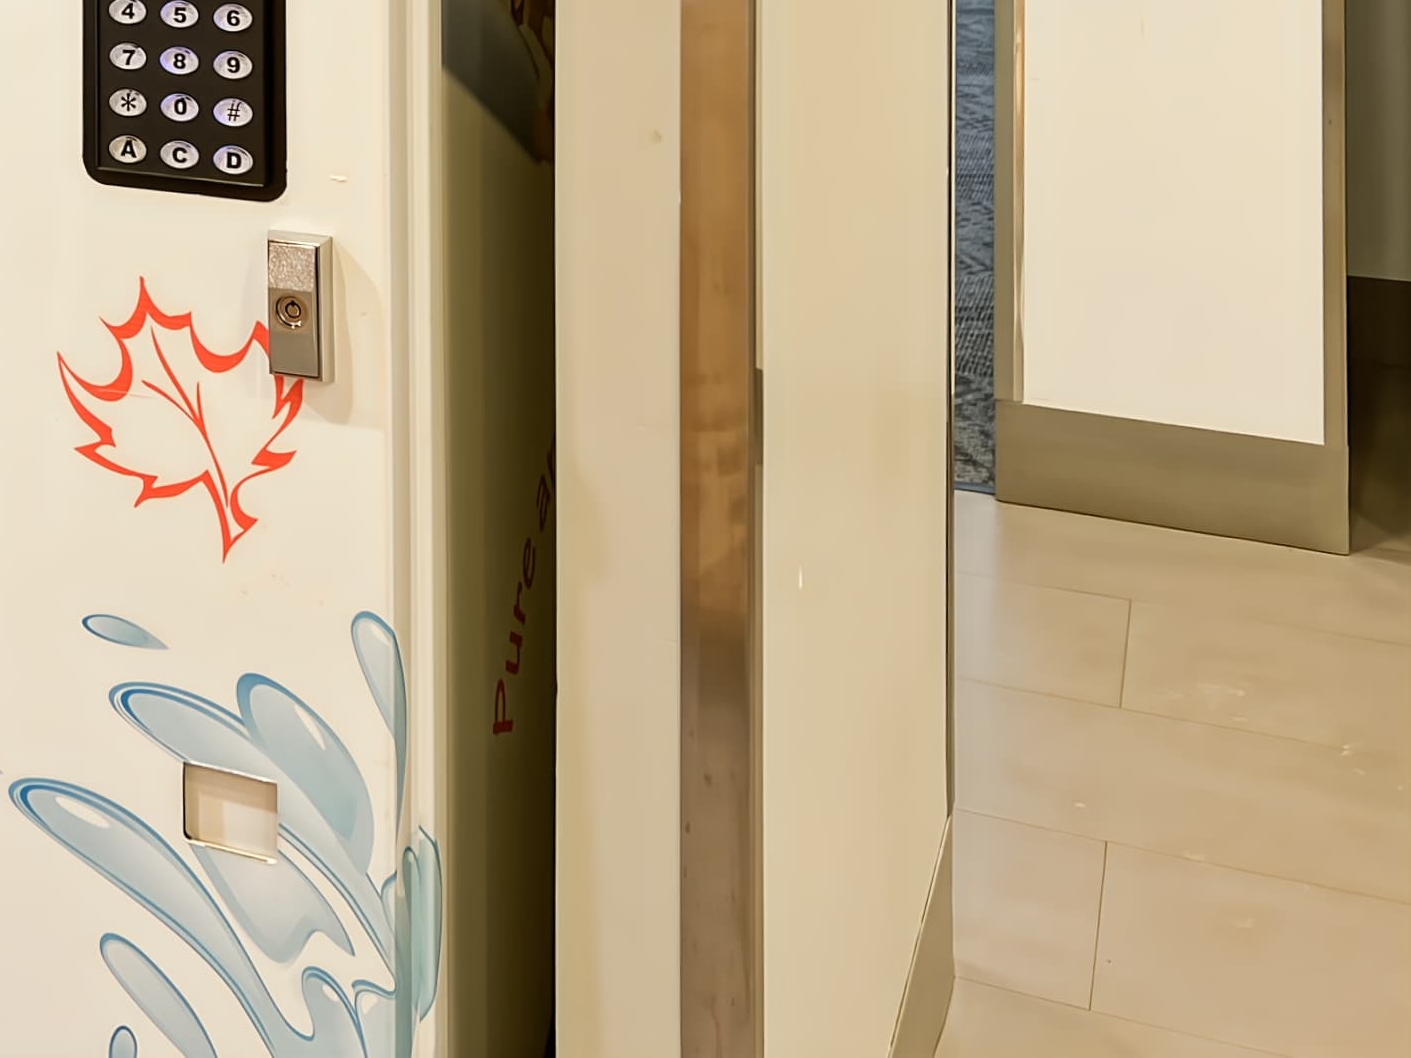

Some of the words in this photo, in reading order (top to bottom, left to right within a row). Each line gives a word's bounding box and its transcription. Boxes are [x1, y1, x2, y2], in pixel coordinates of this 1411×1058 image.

[121, 3, 135, 19] 4
[173, 7, 187, 23] 5
[226, 10, 240, 26] 6
[122, 49, 136, 65] 7
[173, 53, 186, 69] 8
[226, 57, 240, 73] 9
[174, 98, 187, 115] 0
[120, 140, 137, 158] A
[172, 147, 187, 163] C
[226, 152, 242, 169] D
